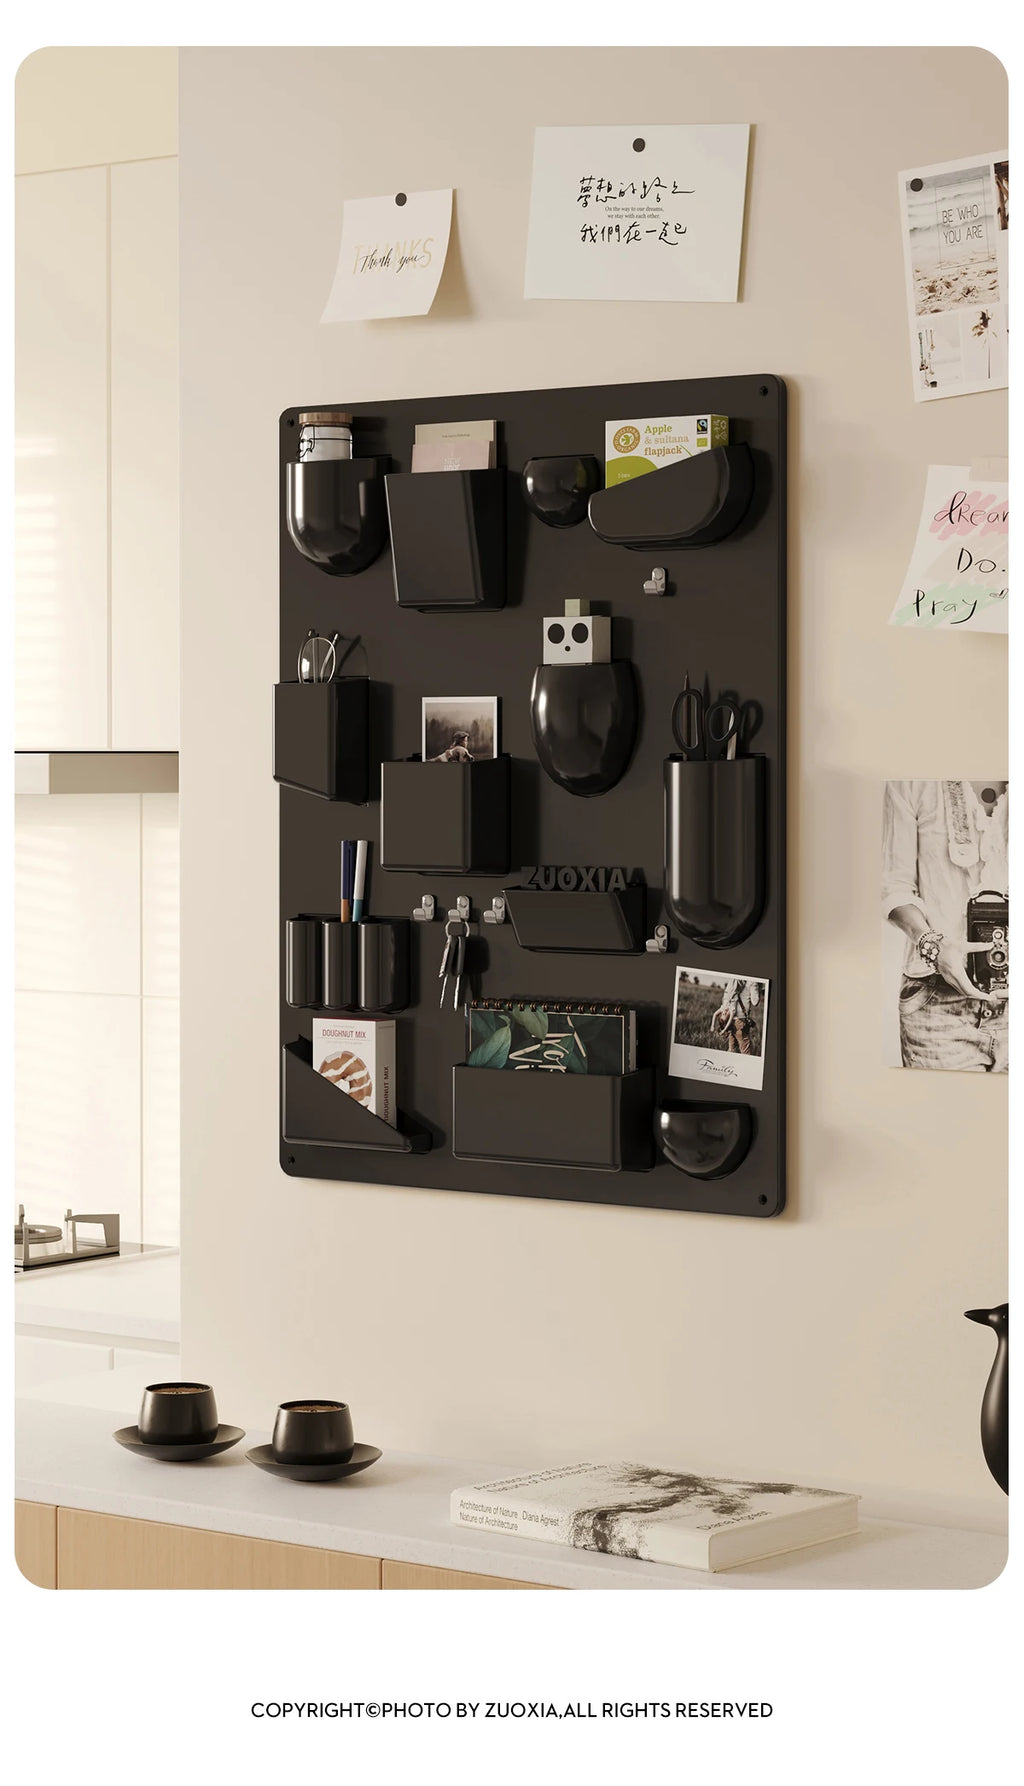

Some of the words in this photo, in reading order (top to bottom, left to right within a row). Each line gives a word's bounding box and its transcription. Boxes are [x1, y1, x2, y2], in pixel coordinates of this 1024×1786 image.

[942, 209, 953, 224] BE
[956, 204, 979, 221] WHO
[580, 221, 687, 246] 我們在一起
[943, 229, 961, 244] YOU
[966, 224, 983, 240] ARE
[352, 237, 434, 275] THANKS
[359, 247, 393, 273] Thank
[396, 254, 425, 274] you
[644, 424, 673, 436] Apple
[644, 437, 652, 445] &
[654, 435, 689, 445] sultana
[644, 446, 683, 458] flapjack
[913, 589, 977, 624] Pray
[520, 866, 626, 892] ZUOXIA
[322, 1028, 354, 1038] DOUGHNUT
[355, 1030, 367, 1039] MIX
[459, 1500, 492, 1514] Architecture
[492, 1506, 499, 1515] of
[499, 1507, 519, 1519] Nature
[522, 1510, 539, 1523] Diana
[540, 1514, 560, 1527] Agrest
[459, 1511, 478, 1524] Nature
[478, 1516, 485, 1524] of
[485, 1517, 519, 1531] Architecture
